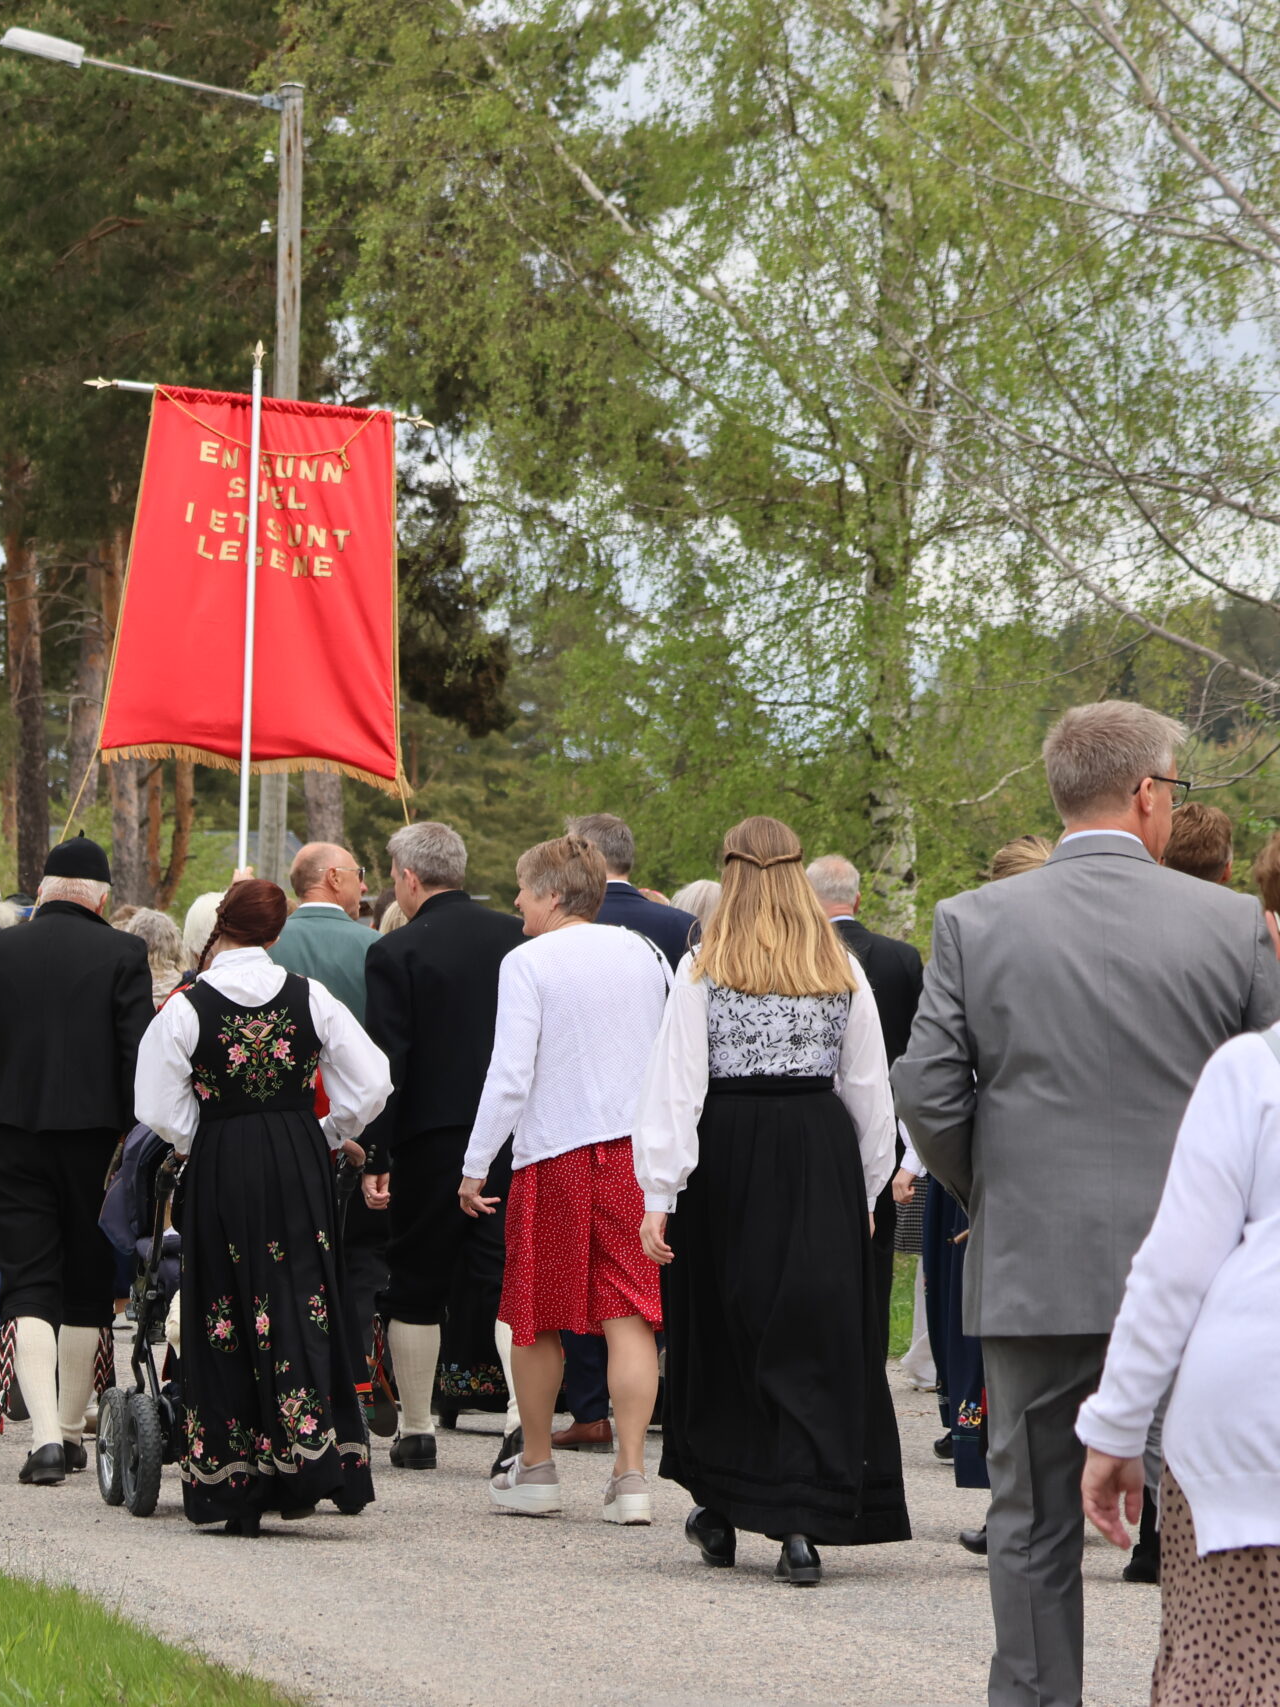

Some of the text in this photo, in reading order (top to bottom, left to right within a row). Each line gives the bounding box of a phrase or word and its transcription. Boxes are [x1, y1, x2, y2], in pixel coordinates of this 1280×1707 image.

[200, 441, 239, 470] EN
[184, 502, 351, 552] I ET SUNT
